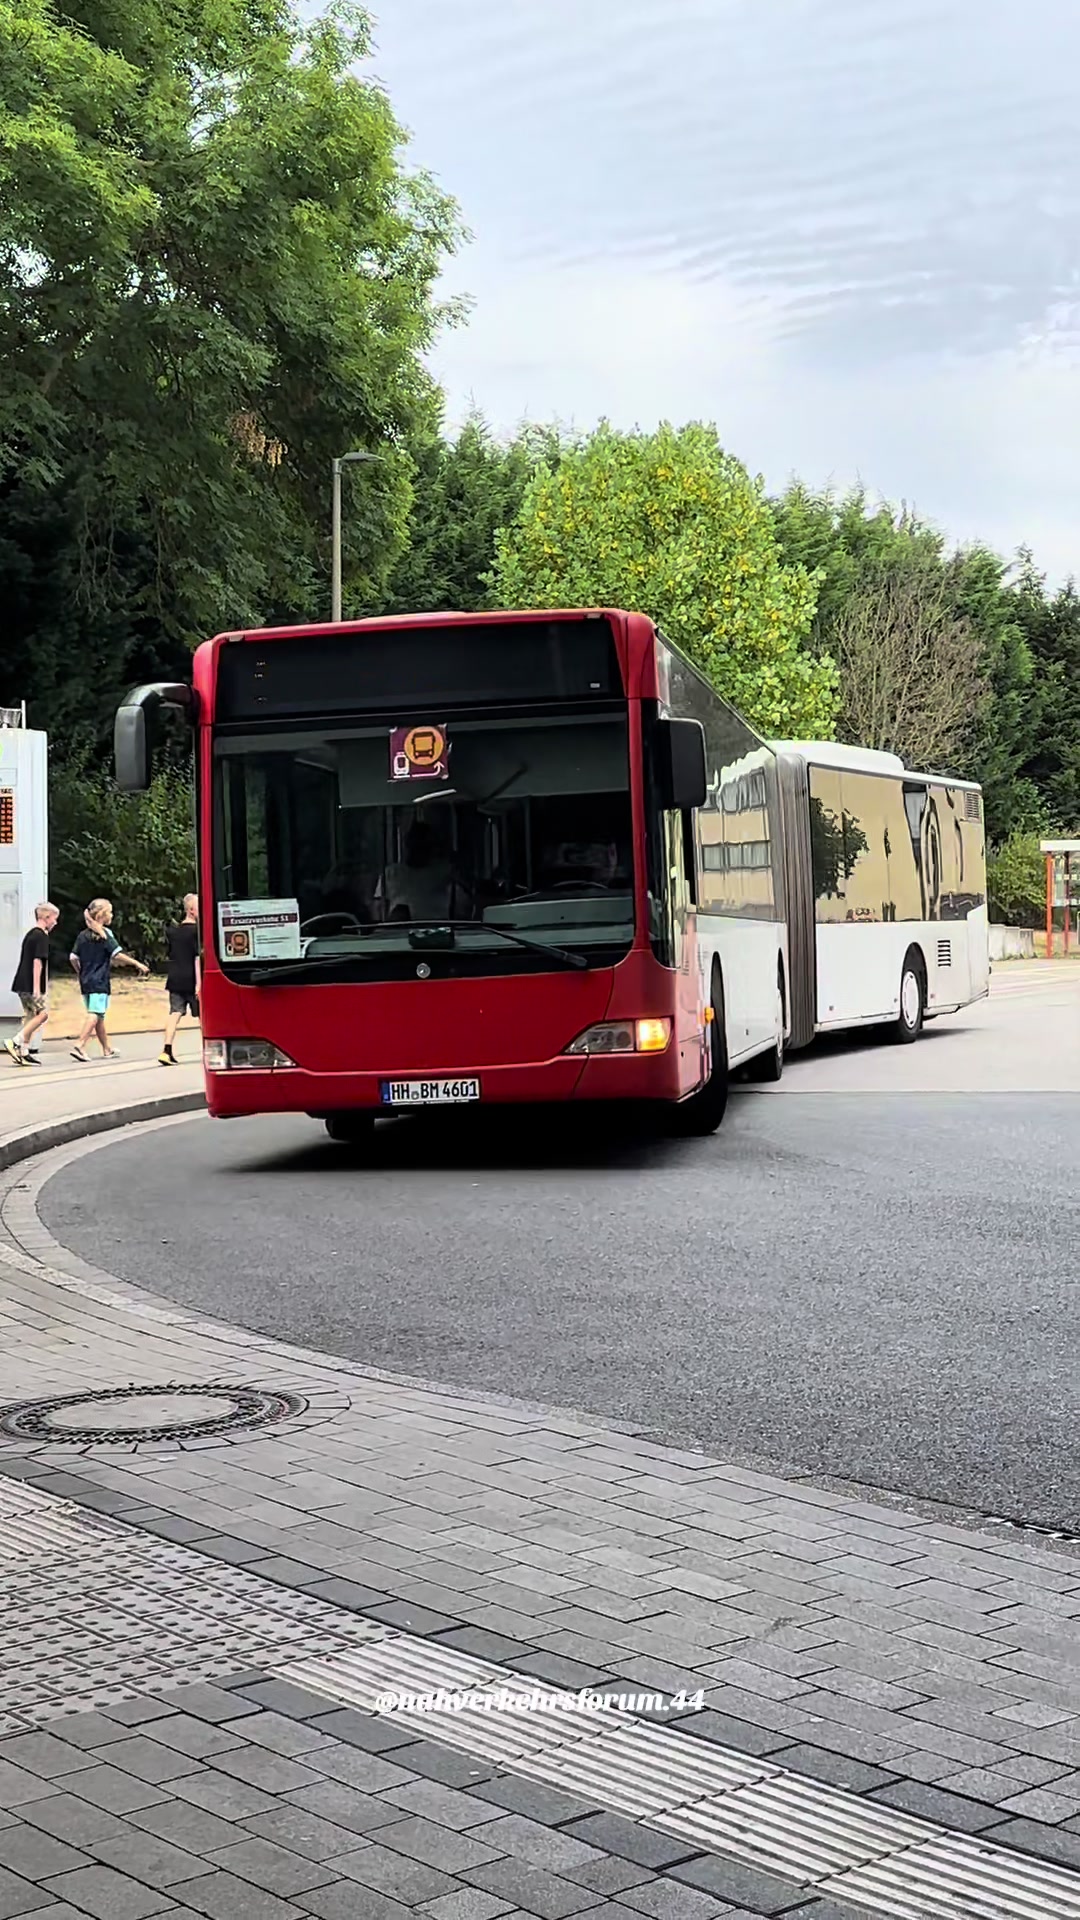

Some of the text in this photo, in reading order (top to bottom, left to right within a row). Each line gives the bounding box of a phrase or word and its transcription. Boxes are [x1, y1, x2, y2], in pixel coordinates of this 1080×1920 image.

[391, 1081, 478, 1100] HH BM 4601
